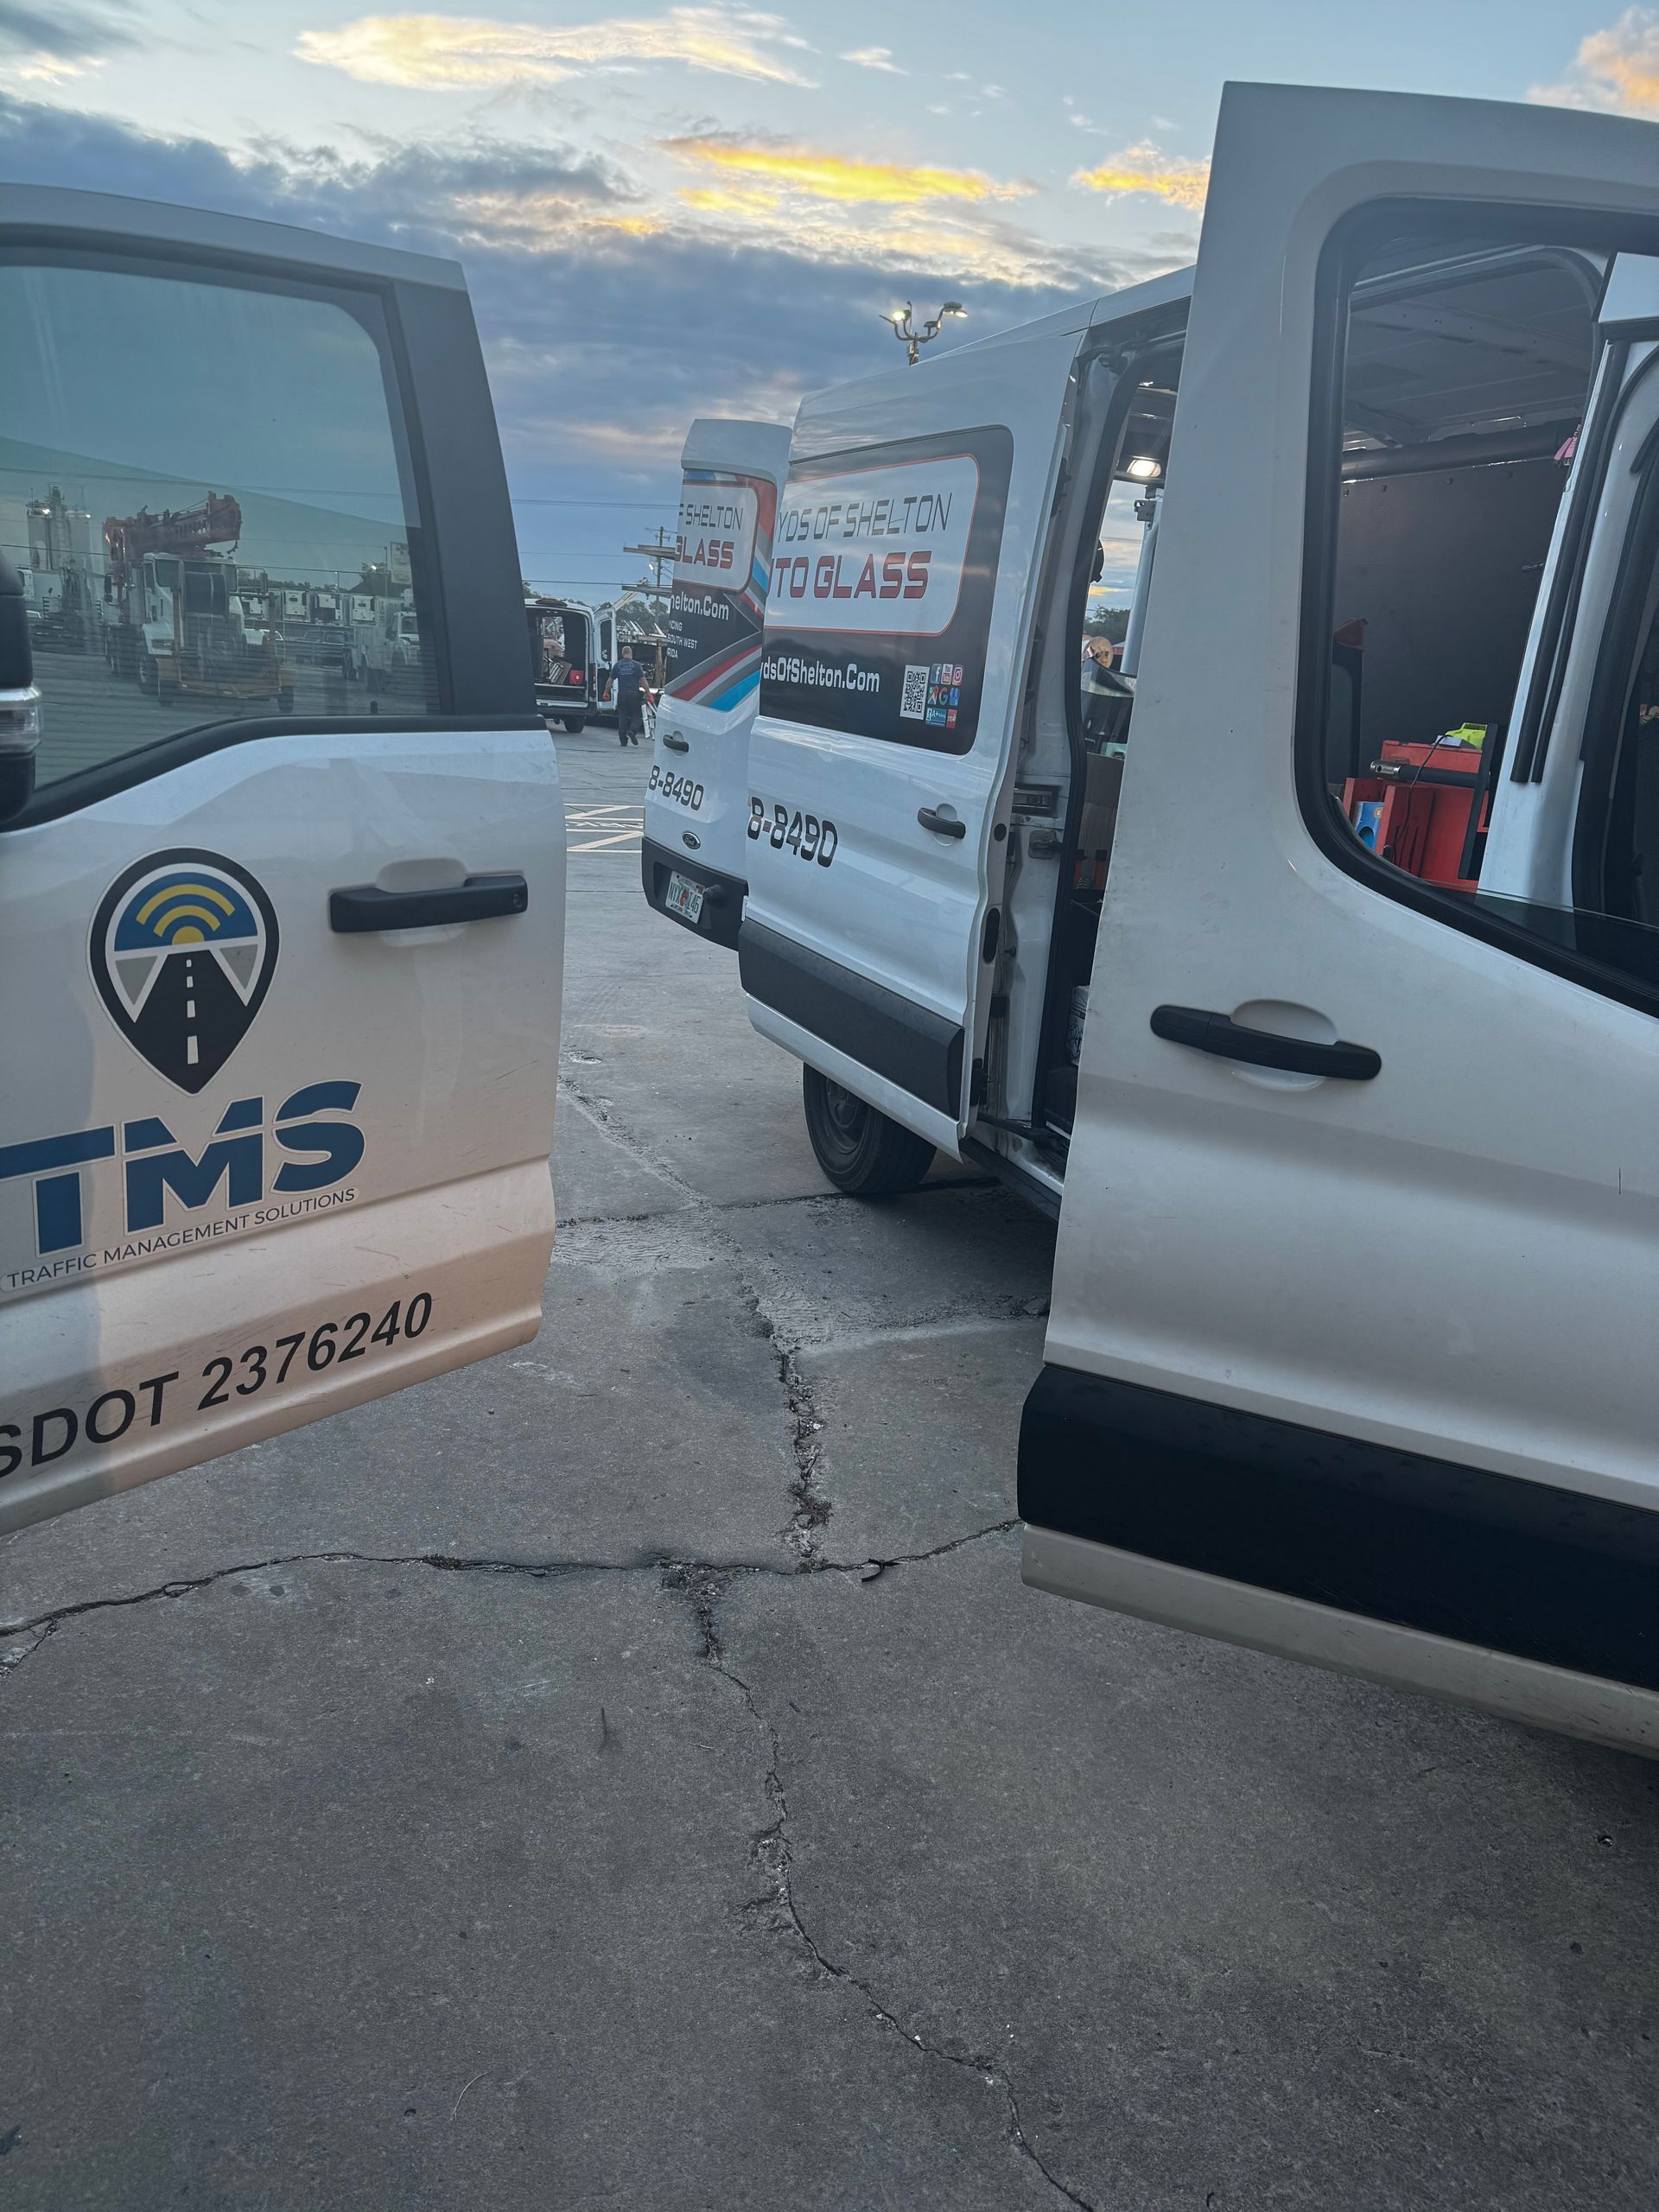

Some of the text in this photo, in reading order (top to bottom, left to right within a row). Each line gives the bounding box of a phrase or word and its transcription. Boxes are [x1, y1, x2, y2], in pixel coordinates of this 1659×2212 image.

[686, 504, 744, 531] SHELTON
[779, 493, 952, 542] YDS OF SHELTON
[814, 551, 931, 599] GLASS
[667, 634, 697, 649] SOUTH WEST
[649, 766, 704, 810] 8-8490
[747, 796, 838, 868] 8-8490
[0, 1080, 365, 1255] TMS
[6, 1187, 356, 1288] TRAFFIC MANAGEMENT SOLUTIONS
[0, 1292, 432, 1478] SDOT 2376240
